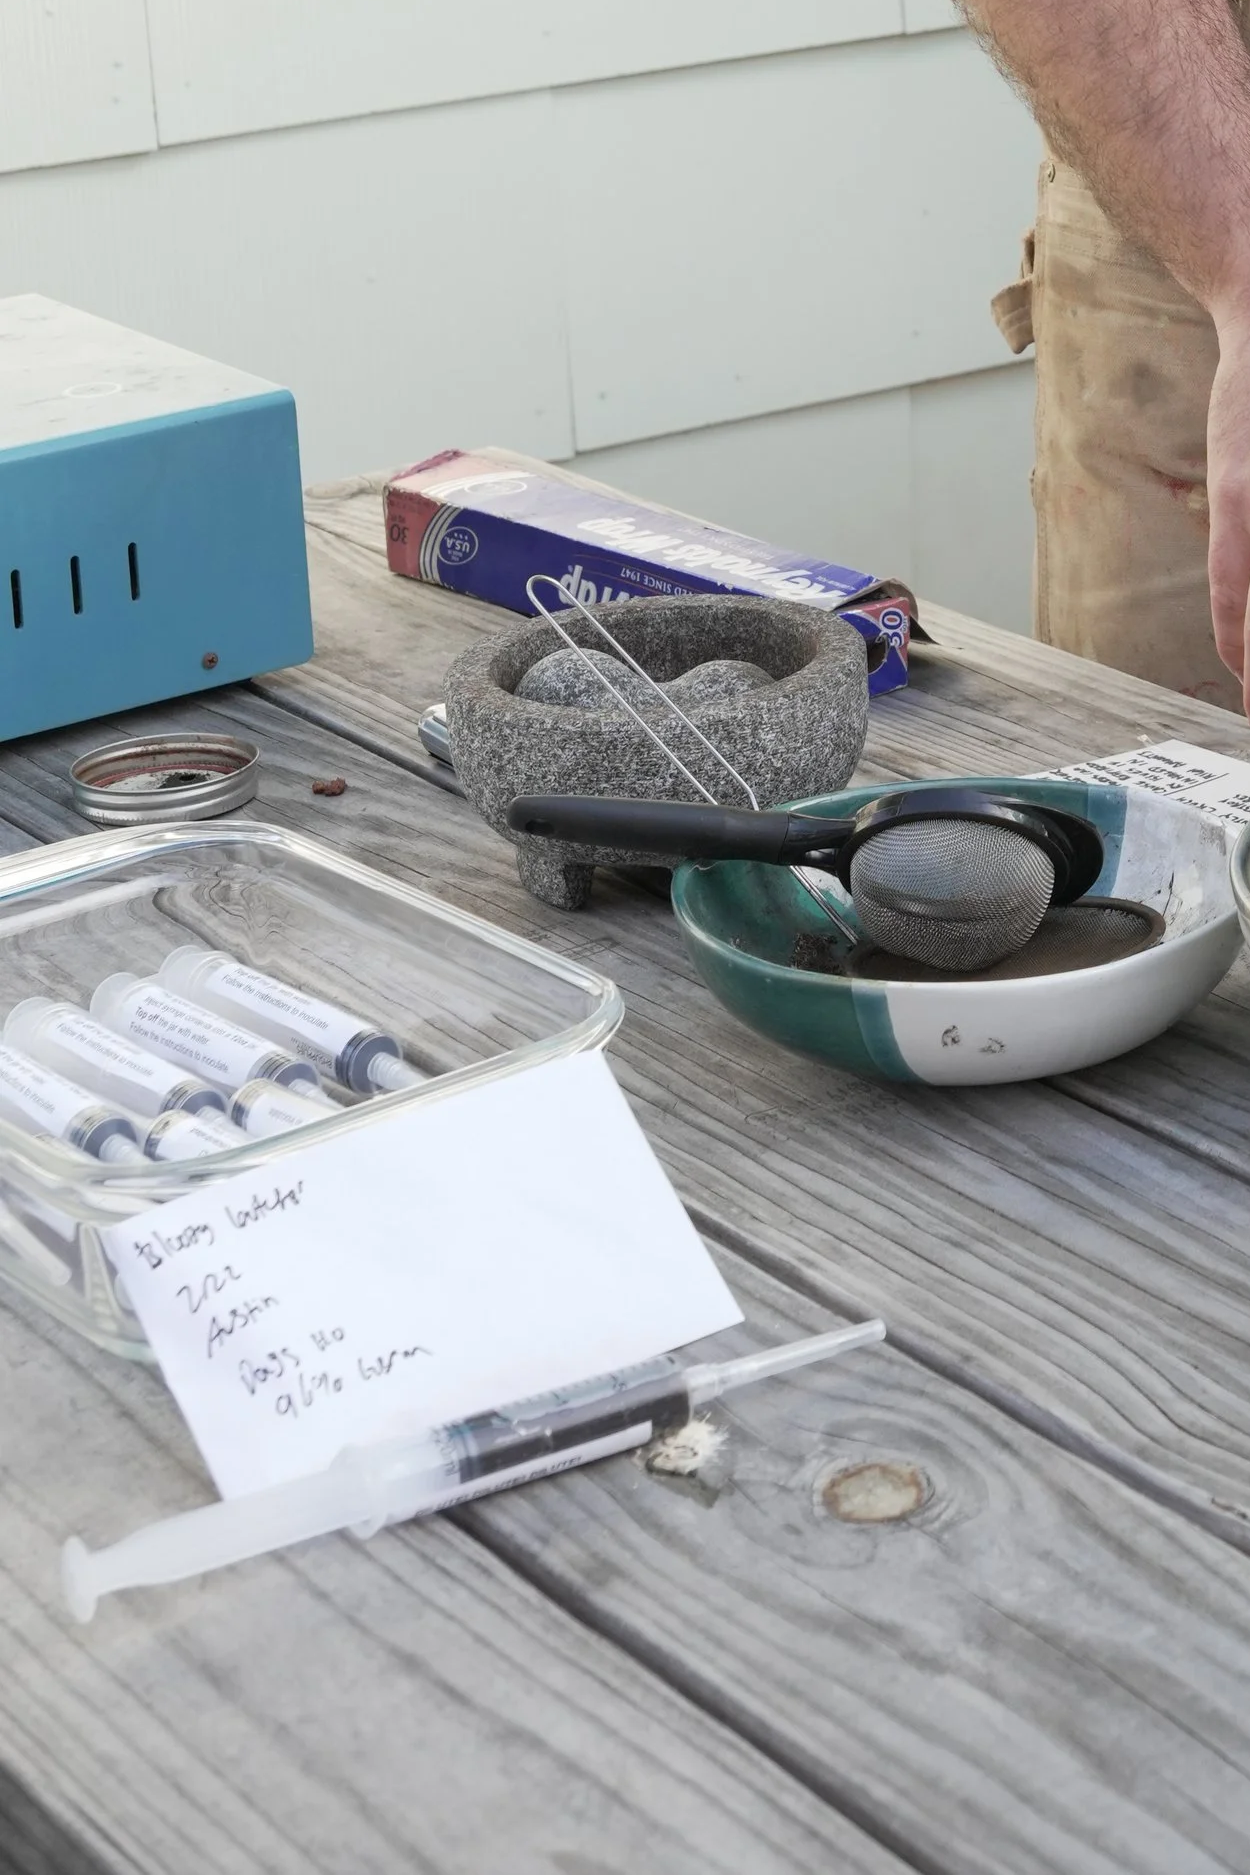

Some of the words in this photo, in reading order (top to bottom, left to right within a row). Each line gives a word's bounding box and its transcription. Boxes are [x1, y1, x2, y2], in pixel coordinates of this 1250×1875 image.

[445, 536, 470, 553] U.S.A.
[577, 516, 684, 555] Wrap
[620, 567, 641, 582] 1947
[661, 543, 848, 601] Reynolds
[643, 574, 672, 594] SINCE
[135, 1006, 147, 1020] Top
[148, 1013, 159, 1024] off
